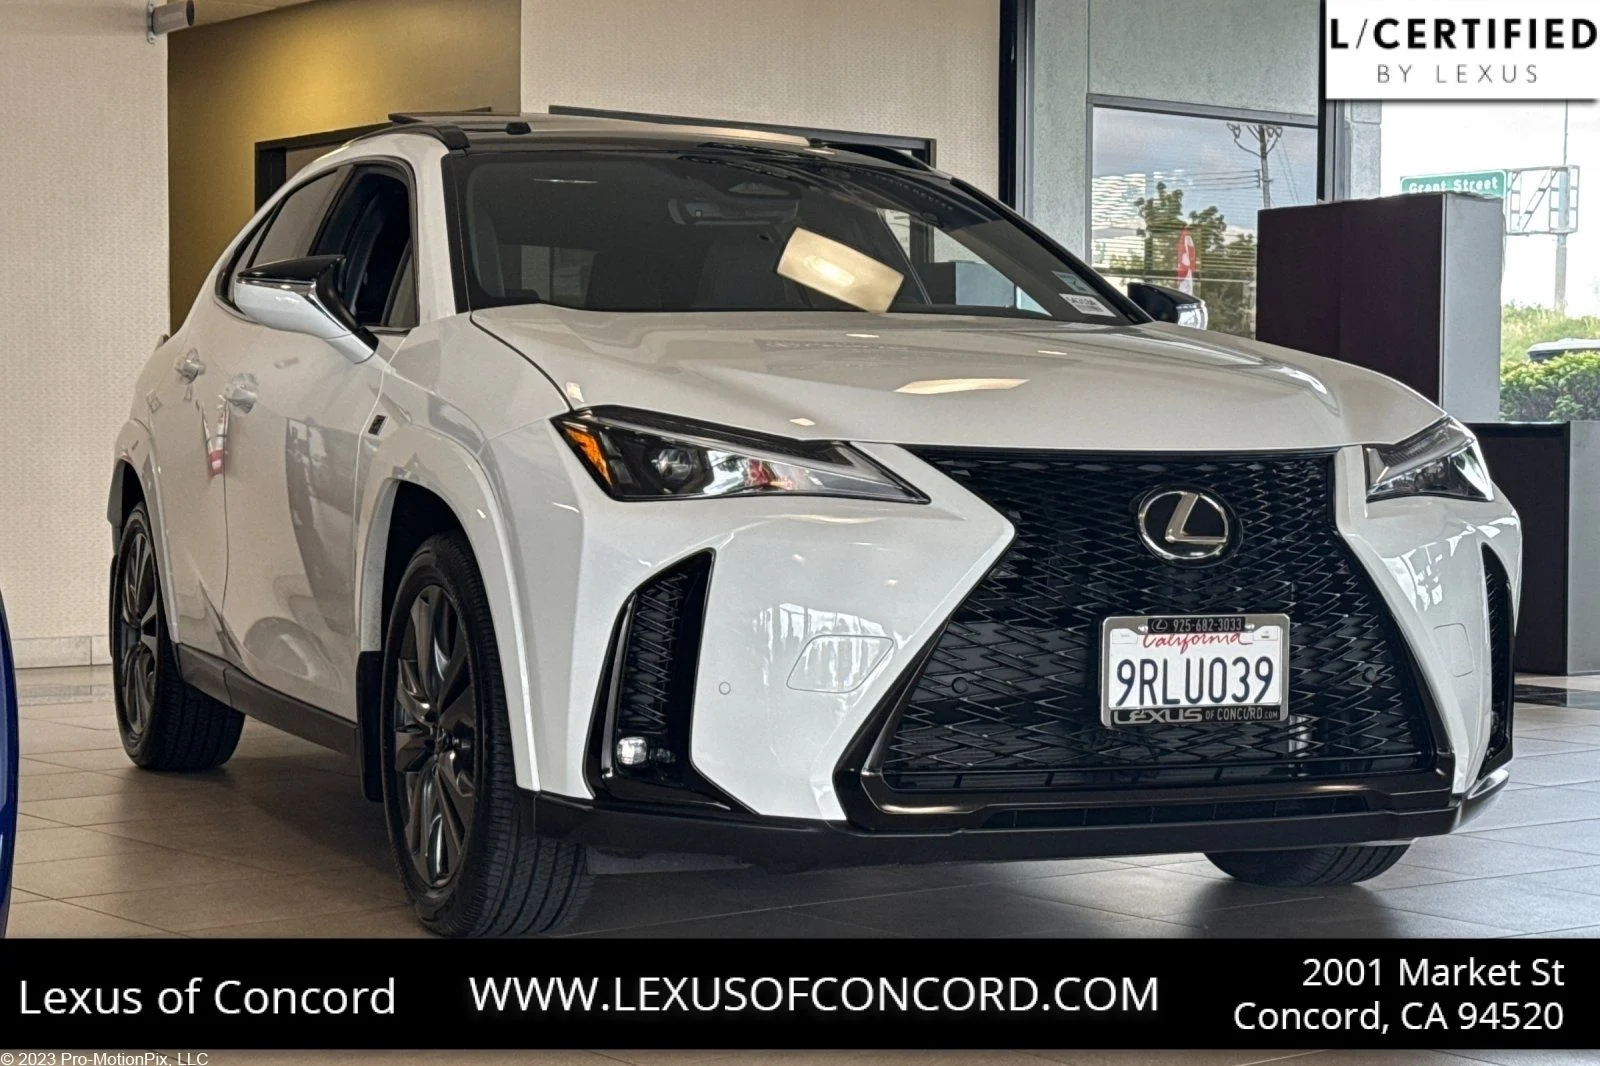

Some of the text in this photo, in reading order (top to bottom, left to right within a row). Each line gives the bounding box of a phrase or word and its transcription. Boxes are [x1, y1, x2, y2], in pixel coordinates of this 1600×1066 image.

[1408, 176, 1498, 194] Grant Street
[1173, 618, 1242, 632] 925-682-3033
[1143, 632, 1253, 655] California
[1115, 656, 1274, 706] 9RLU039
[1113, 708, 1203, 725] LEXUS
